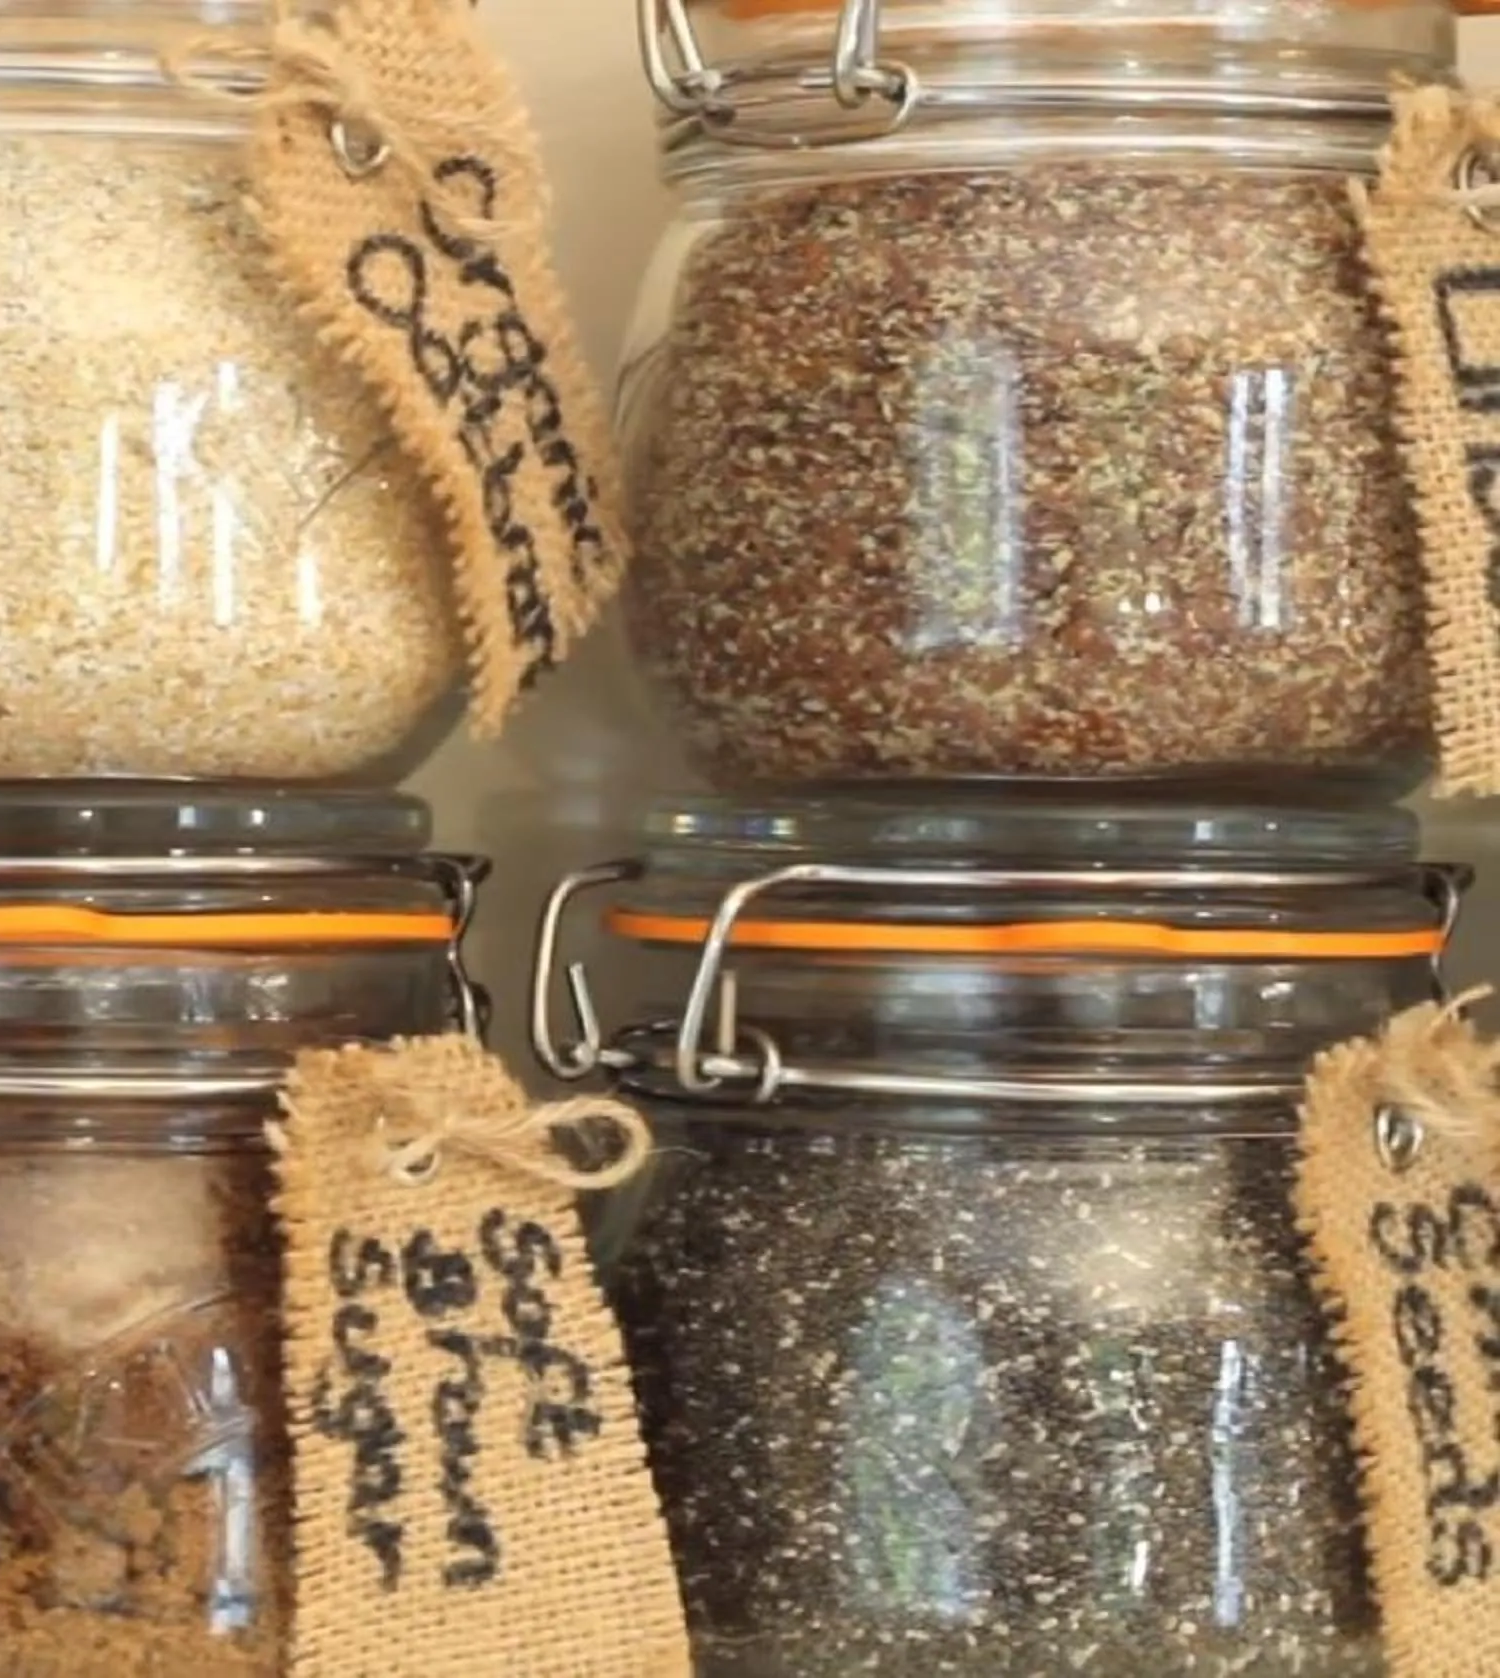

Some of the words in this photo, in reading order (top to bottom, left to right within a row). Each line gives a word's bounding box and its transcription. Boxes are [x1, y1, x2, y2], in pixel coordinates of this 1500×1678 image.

[421, 154, 610, 590] Organic
[313, 1226, 404, 1594] Sugar
[402, 1228, 501, 1588] Brown
[479, 1207, 602, 1460] Soft
